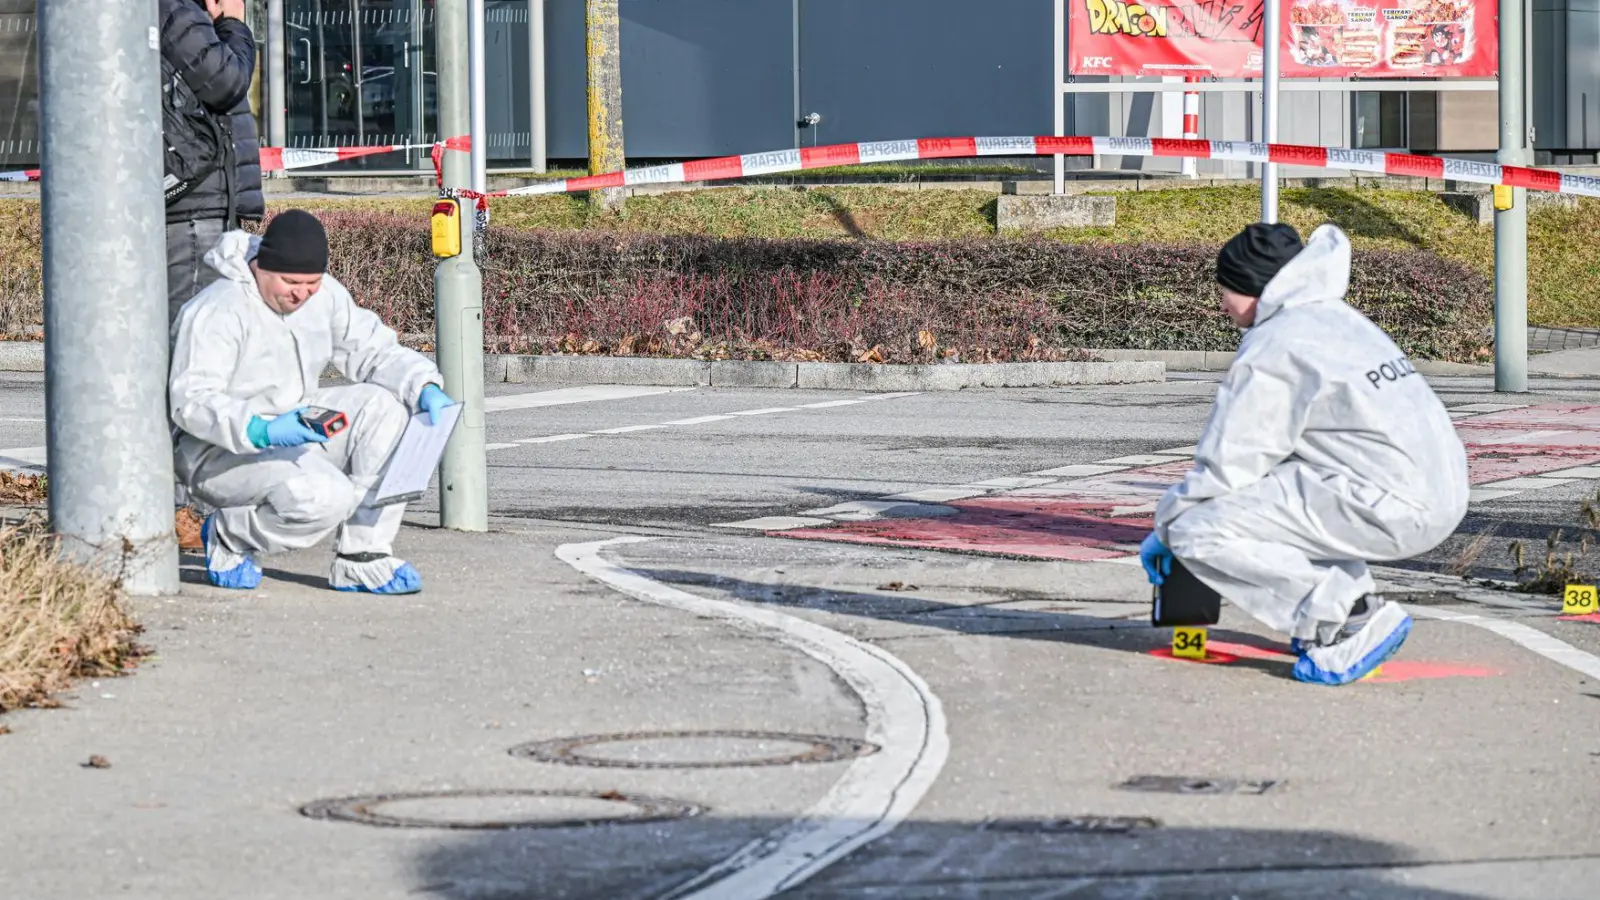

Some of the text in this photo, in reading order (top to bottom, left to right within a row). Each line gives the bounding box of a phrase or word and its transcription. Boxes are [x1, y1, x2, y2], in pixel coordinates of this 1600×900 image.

[1085, 0, 1168, 37] DRAGON
[1082, 56, 1112, 68] KFC
[1566, 590, 1592, 607] 38
[1175, 631, 1204, 651] 34
